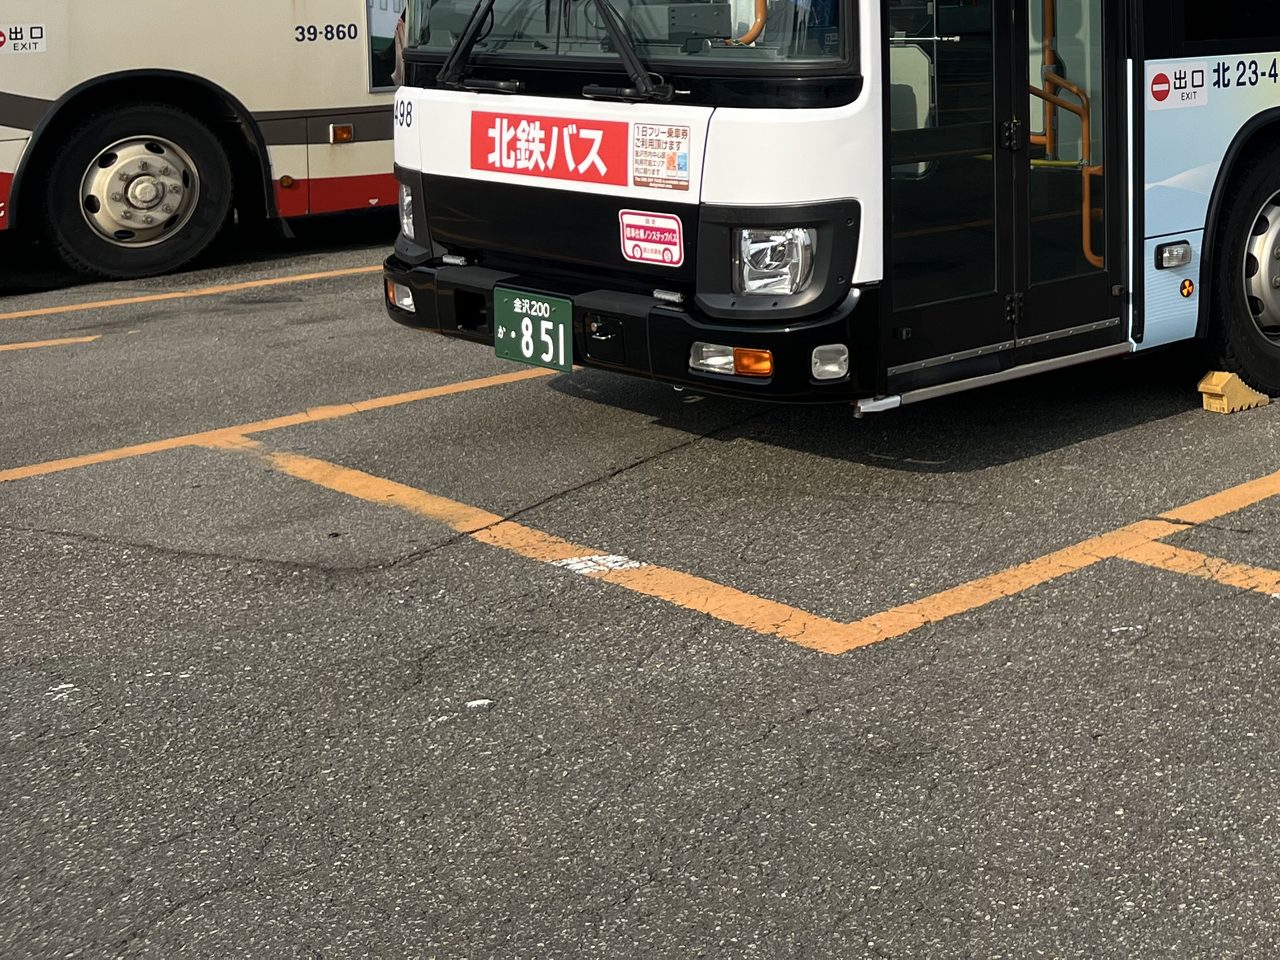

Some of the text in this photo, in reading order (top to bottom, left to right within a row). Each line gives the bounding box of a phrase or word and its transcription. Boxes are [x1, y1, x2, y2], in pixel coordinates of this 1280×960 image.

[9, 26, 43, 41] 出口
[295, 23, 358, 42] 39-860
[13, 42, 39, 51] EXIT
[1173, 69, 1205, 90] 出口
[1212, 61, 1231, 88] 北
[1181, 91, 1197, 101] EXIT
[487, 117, 608, 177] 北鉄バス
